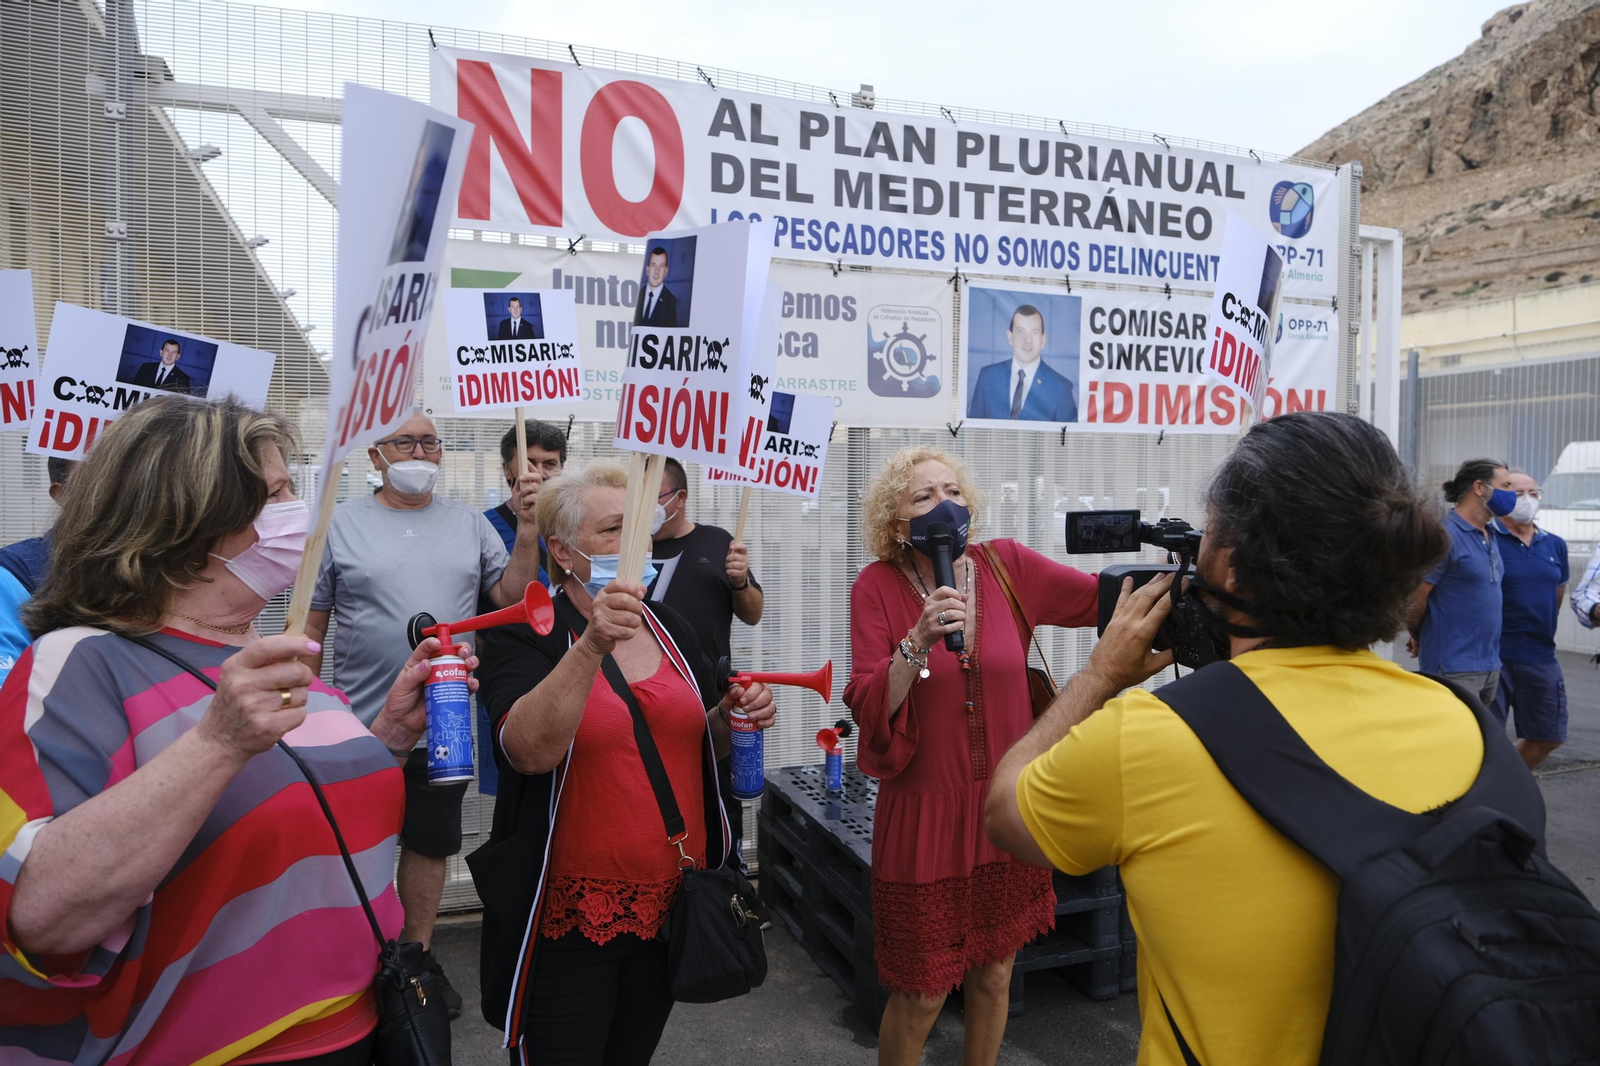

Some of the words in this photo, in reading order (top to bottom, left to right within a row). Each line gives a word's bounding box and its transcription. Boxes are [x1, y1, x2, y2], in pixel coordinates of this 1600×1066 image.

[456, 58, 685, 237] NO
[707, 97, 779, 147] AL
[799, 110, 936, 165] PLAN
[956, 130, 1245, 200] PLURIANUAL
[710, 151, 814, 204] DEL
[833, 168, 1213, 241] MEDITERRÁNEO
[773, 215, 945, 262] PESCADORES
[954, 232, 989, 265] NO
[997, 235, 1081, 272] SOMOS
[1288, 318, 1329, 332] OPP-71
[1288, 332, 1305, 341] Lonja
[457, 363, 581, 407] ¡DIMISIÓN!
[776, 377, 858, 392] ARRASTRE
[615, 377, 730, 455] ISIÓN!
[443, 667, 467, 677] cofan
